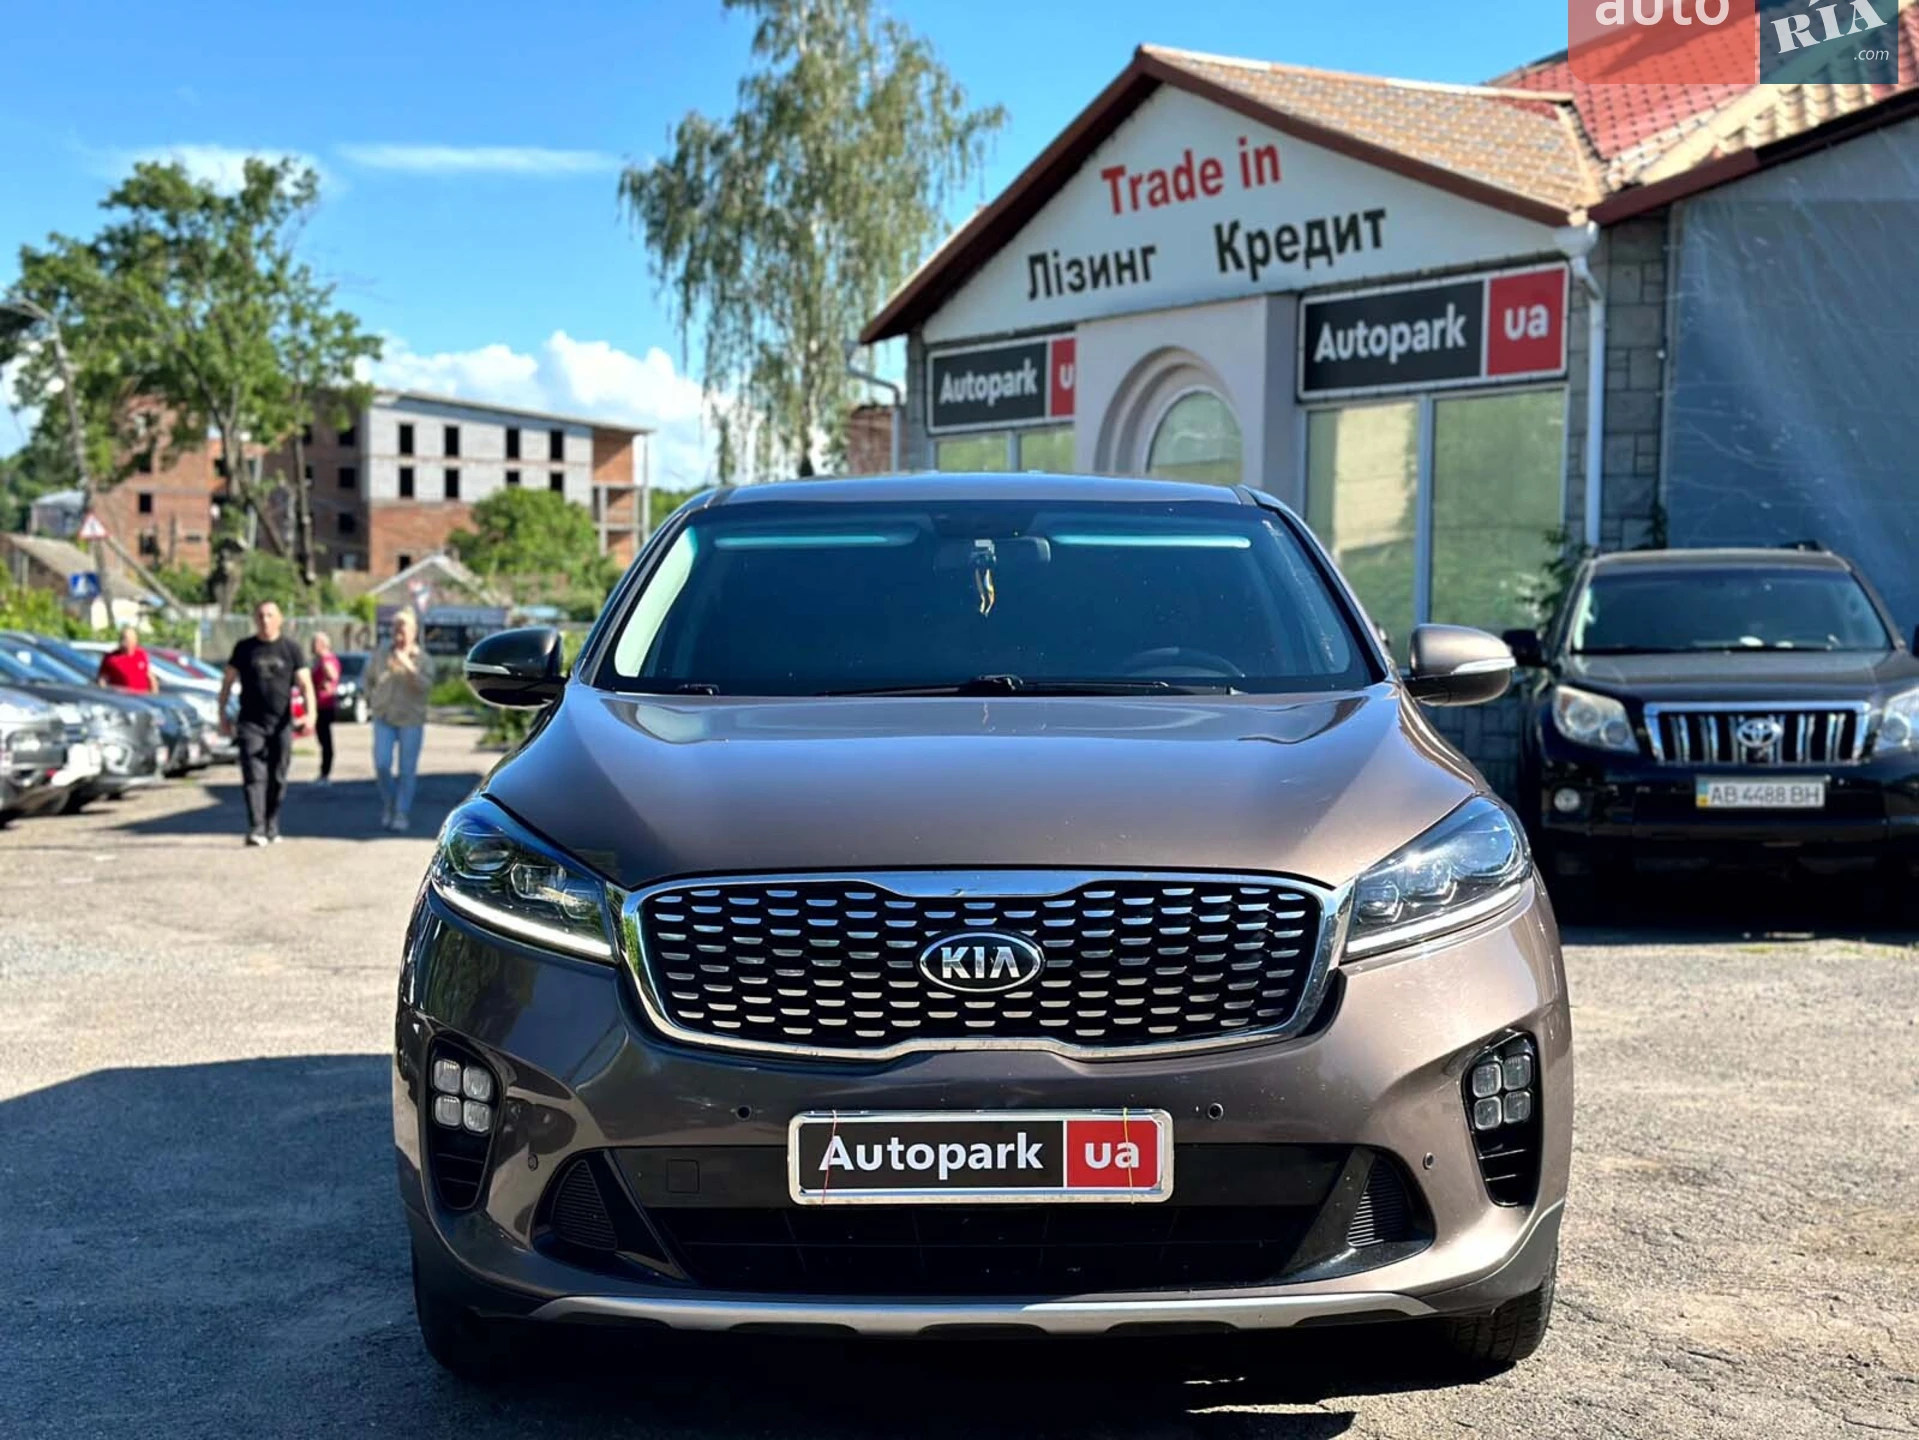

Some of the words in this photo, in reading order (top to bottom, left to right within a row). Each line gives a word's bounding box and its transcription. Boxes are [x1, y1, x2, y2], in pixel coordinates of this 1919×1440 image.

[1101, 149, 1224, 215] Trade
[1238, 137, 1282, 189] in
[1213, 208, 1387, 282] Кредит
[1027, 244, 1157, 301] Лізинг
[1314, 303, 1467, 364] Autopark
[1504, 303, 1549, 341] ua
[939, 358, 1038, 406] Autopark
[1059, 364, 1074, 391] u
[1711, 784, 1738, 804] AB
[1790, 784, 1820, 804] BH
[940, 946, 1020, 979] KIA
[818, 1132, 1044, 1181] Autopark
[1084, 1140, 1140, 1169] ua
